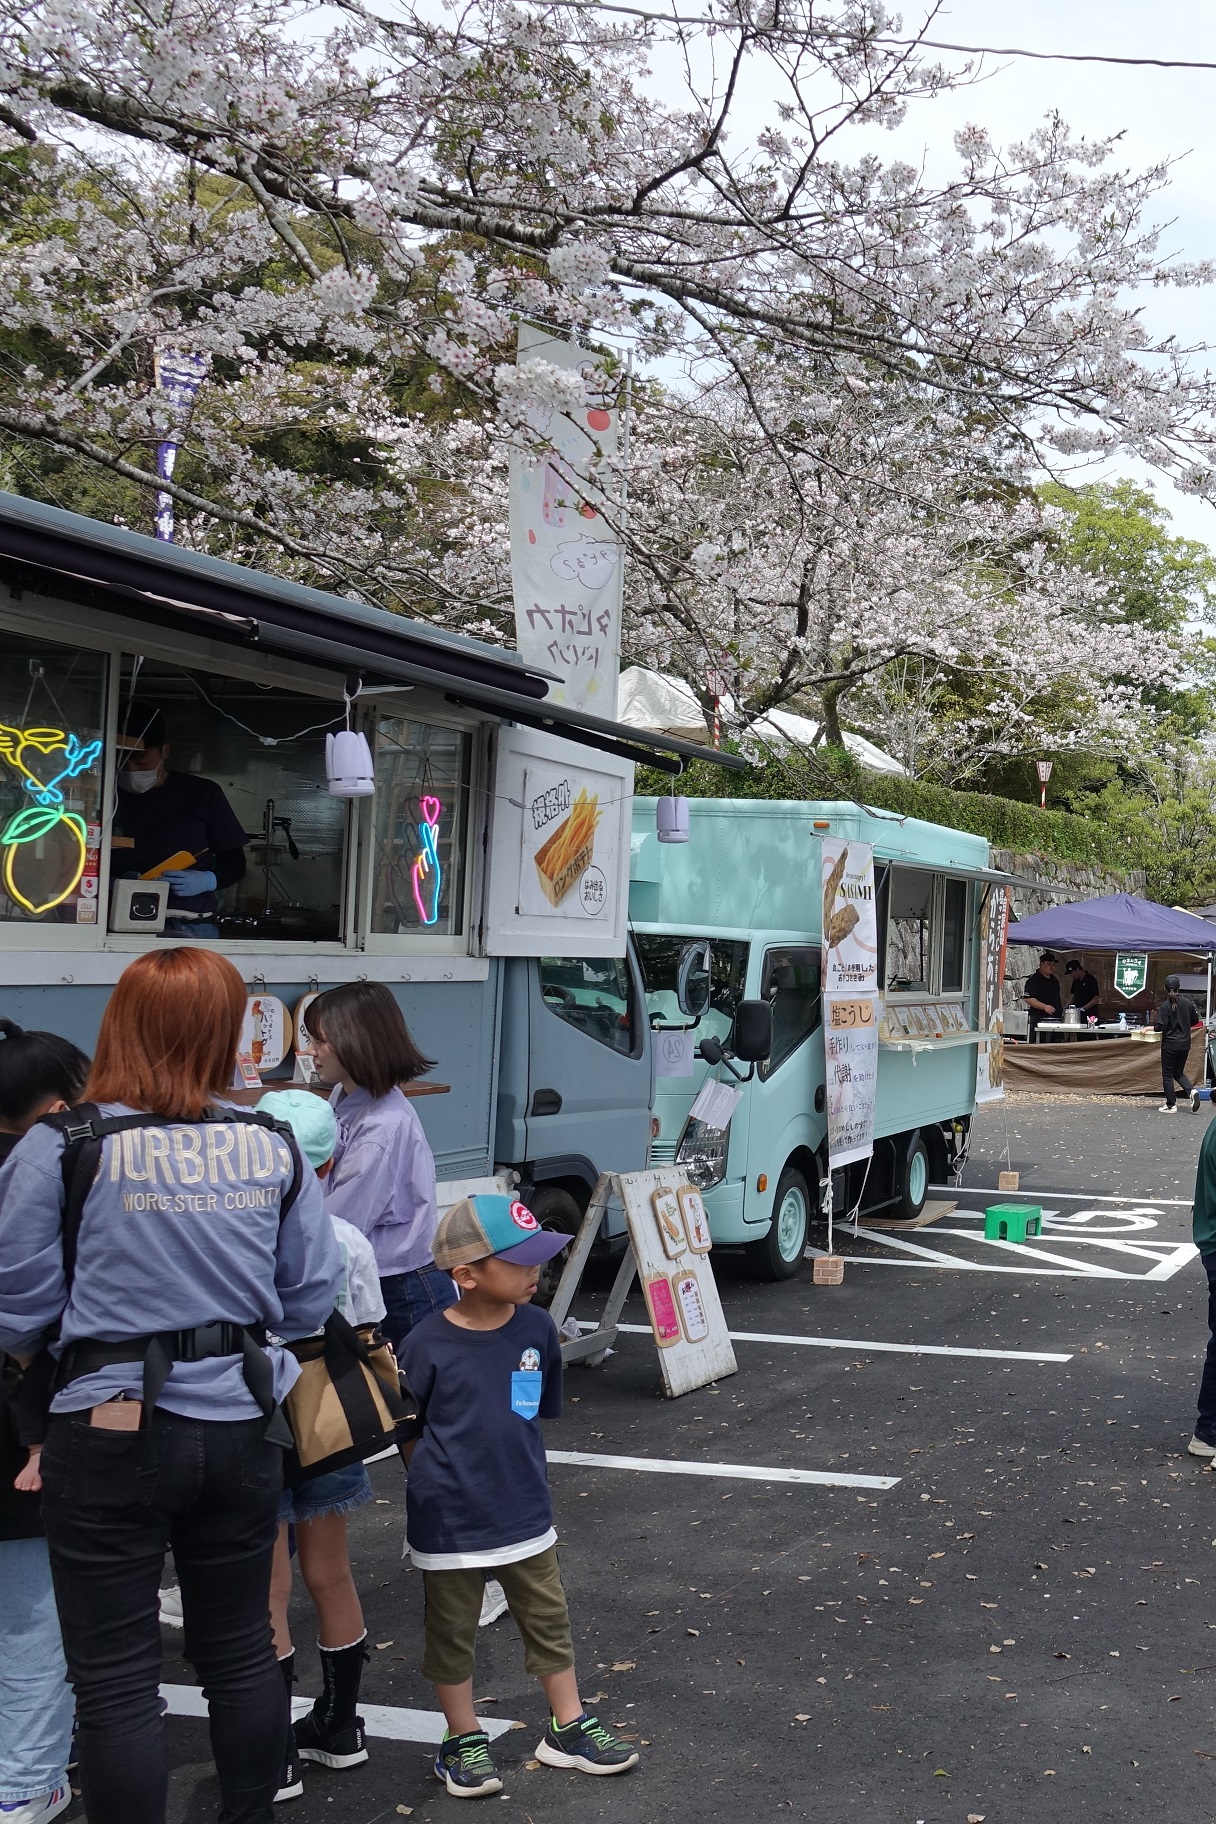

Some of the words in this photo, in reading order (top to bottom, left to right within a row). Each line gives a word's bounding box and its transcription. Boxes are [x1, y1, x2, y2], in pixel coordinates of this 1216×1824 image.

[532, 779, 572, 830] 規格外
[553, 846, 593, 898] ロングポテト
[584, 879, 604, 891] はみ出る
[584, 890, 604, 902] おいしさ
[839, 882, 873, 900] SASAMI
[986, 887, 999, 1017] からあげ
[831, 1005, 872, 1026] 塩こうじ
[224, 1186, 280, 1211] COUNTY
